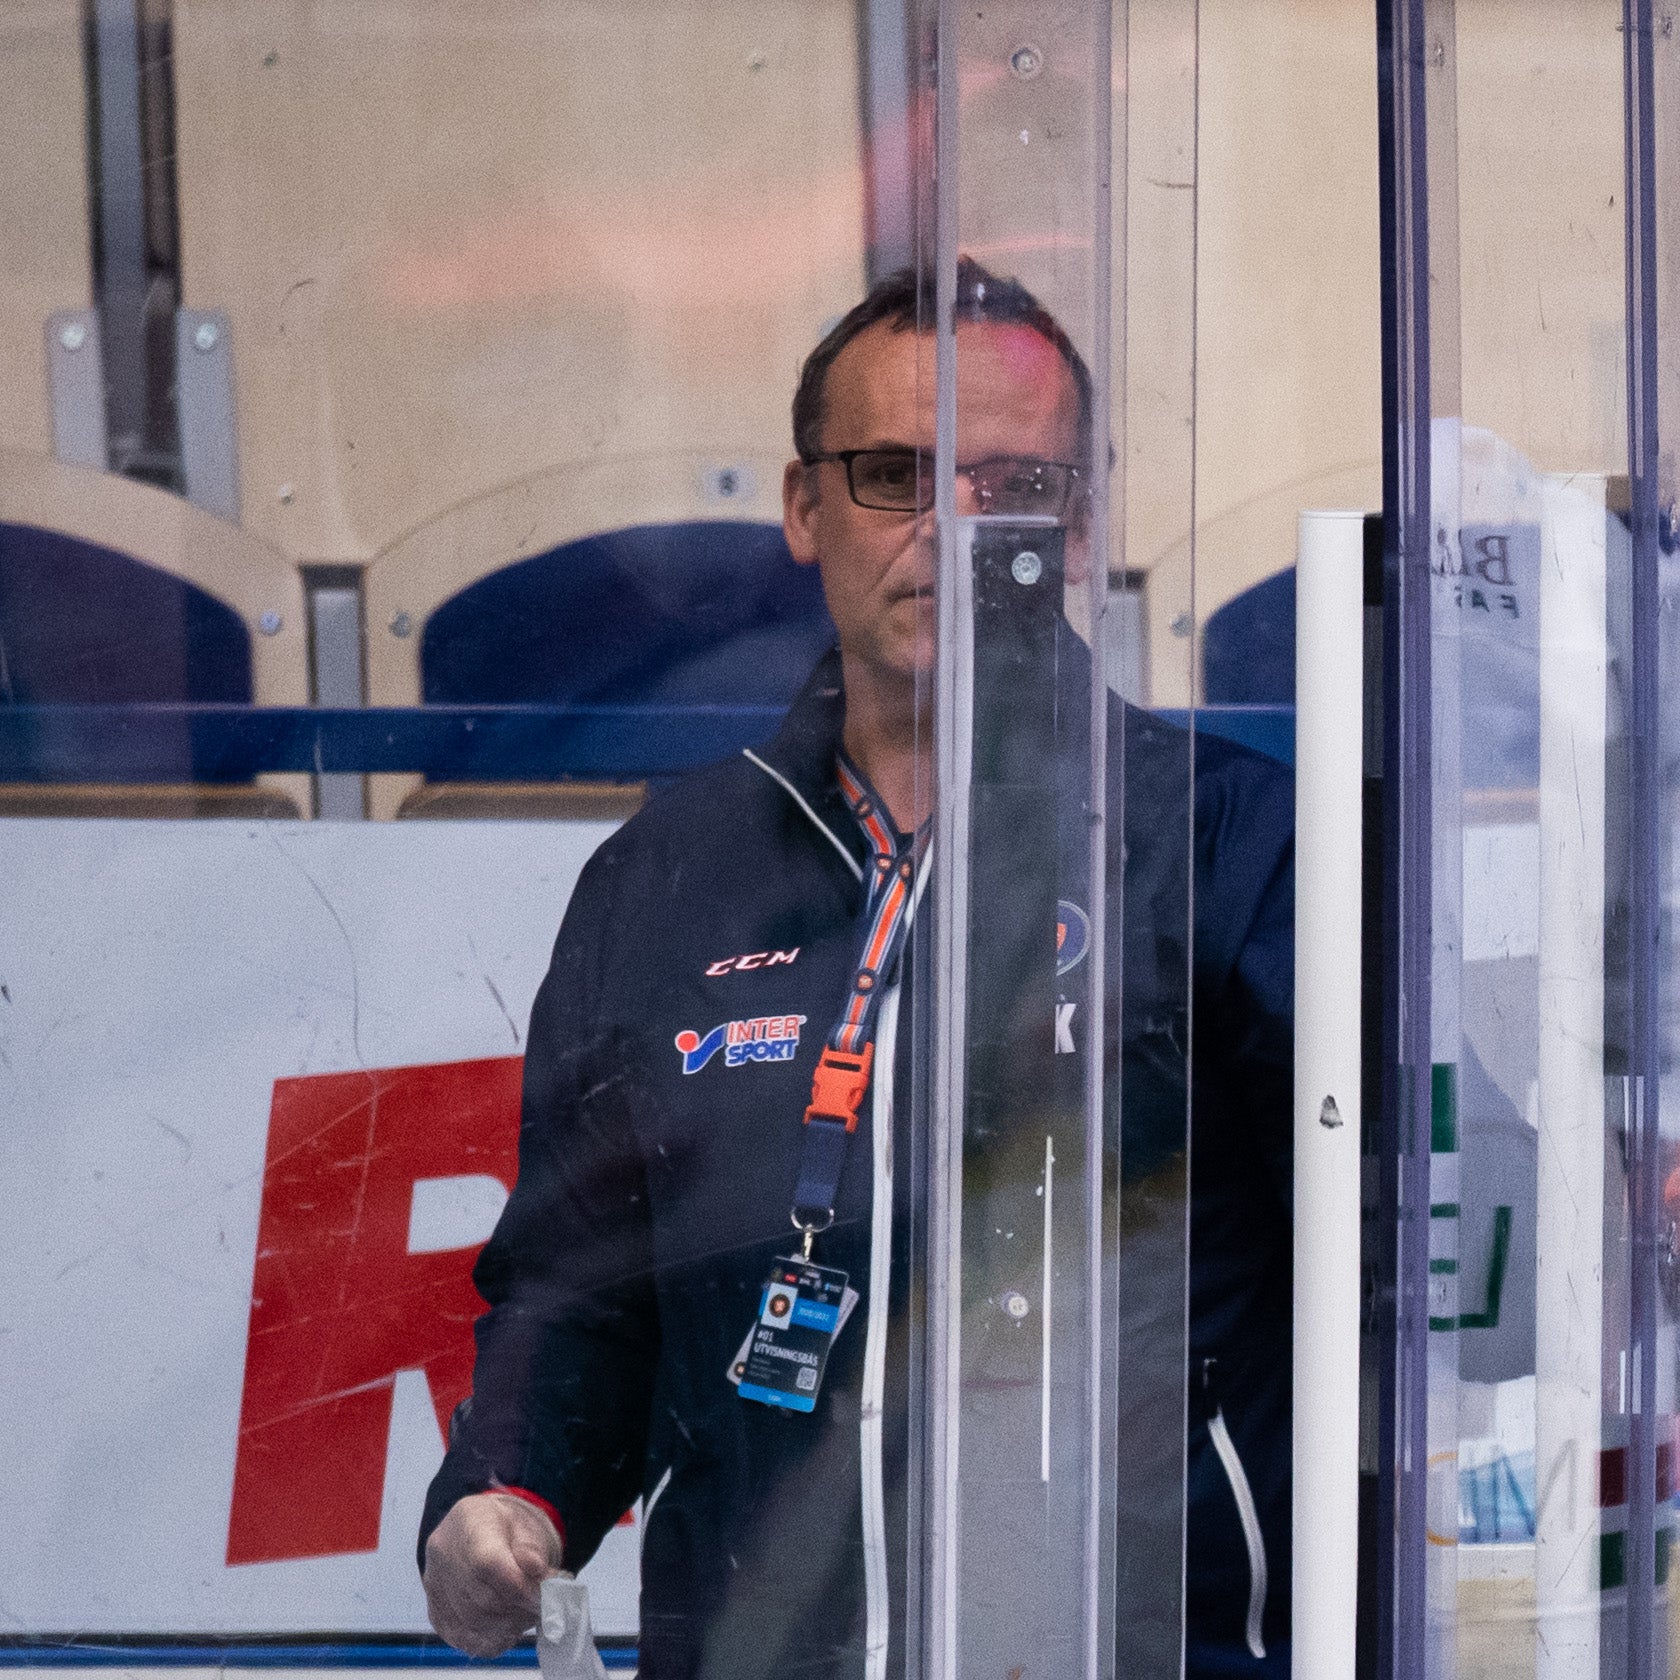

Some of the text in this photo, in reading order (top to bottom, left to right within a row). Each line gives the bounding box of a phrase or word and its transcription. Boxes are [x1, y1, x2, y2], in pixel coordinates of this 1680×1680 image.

[706, 947, 800, 977] CCM
[726, 1014, 801, 1044] INTER
[725, 1038, 798, 1067] SPORT
